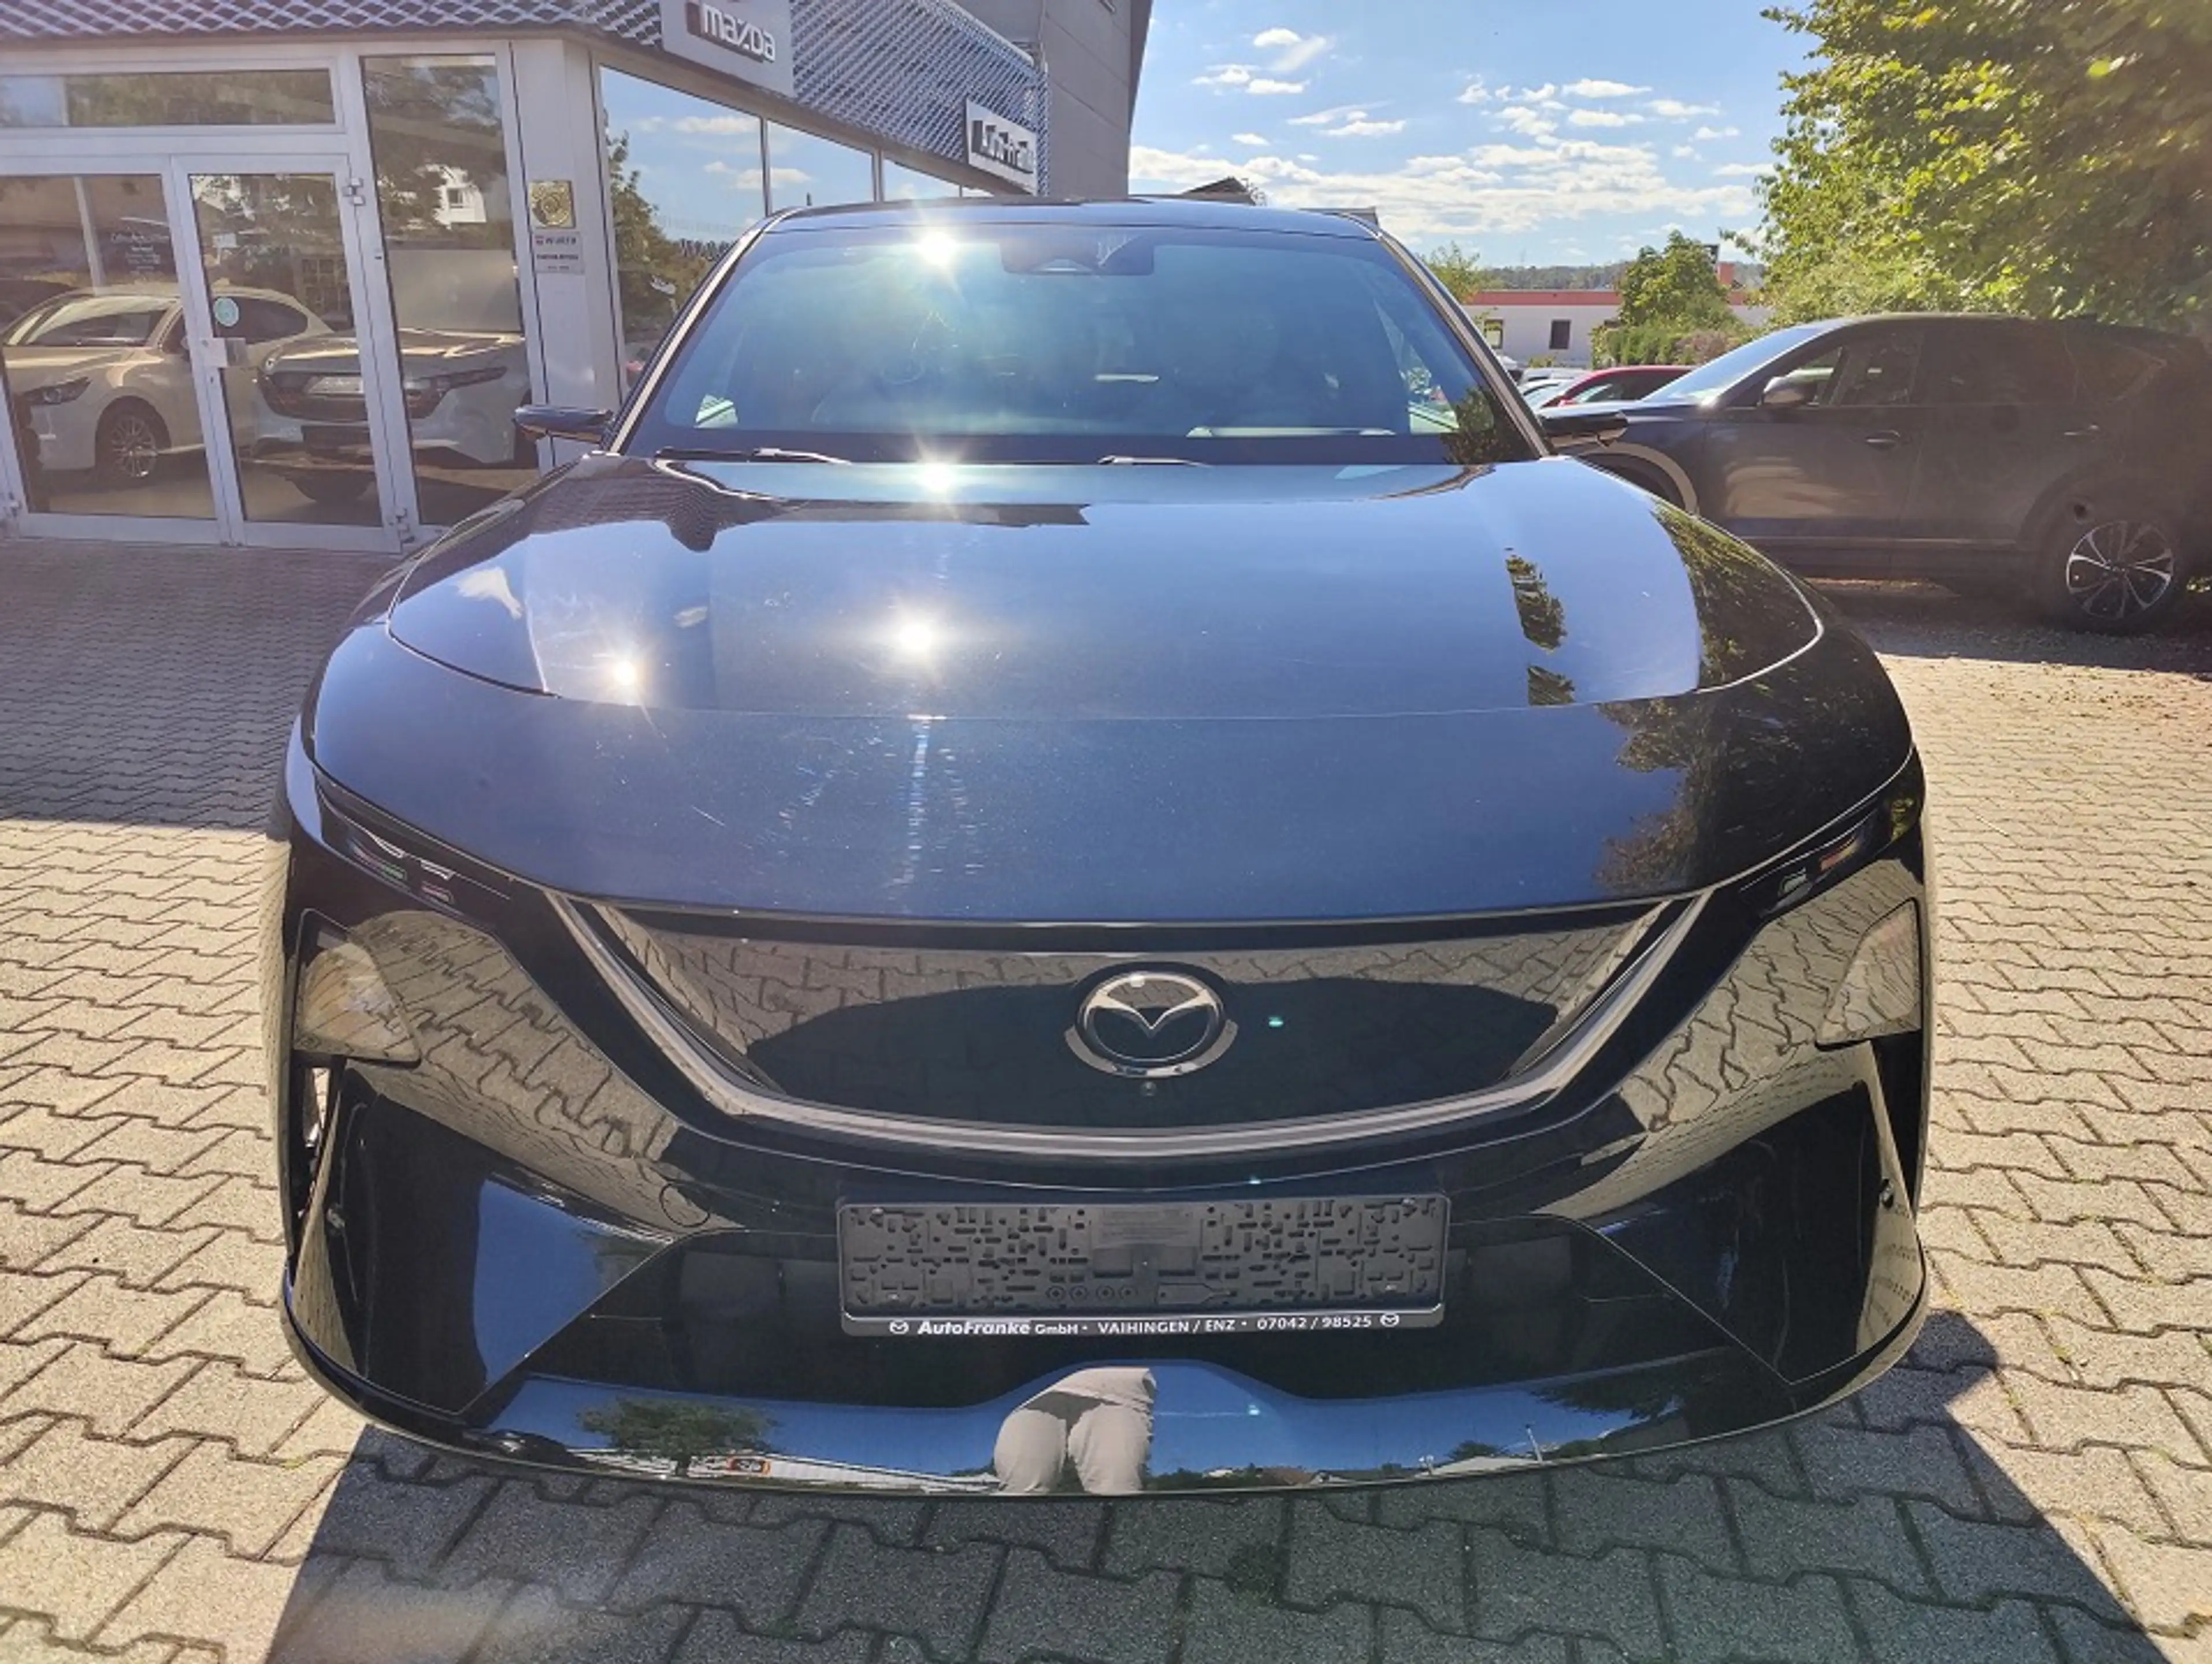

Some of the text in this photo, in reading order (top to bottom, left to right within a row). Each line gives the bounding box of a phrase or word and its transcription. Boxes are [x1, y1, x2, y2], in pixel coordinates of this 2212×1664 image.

[917, 1320, 1031, 1335] AutoFranke
[1035, 1323, 1078, 1335] GmbH
[1098, 1321, 1189, 1334] VAIHINGEN
[1205, 1320, 1236, 1331] ENZ
[1257, 1317, 1307, 1330] 07042
[1322, 1314, 1372, 1328] 98525
